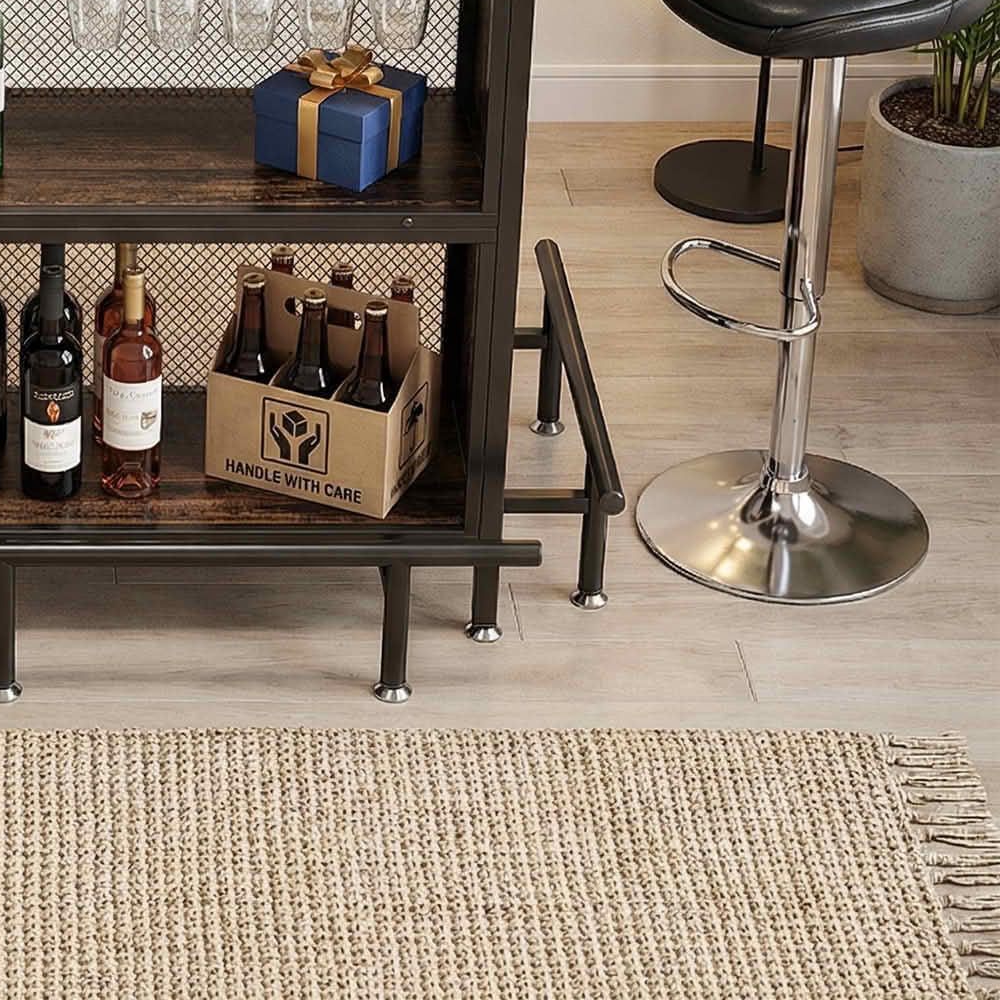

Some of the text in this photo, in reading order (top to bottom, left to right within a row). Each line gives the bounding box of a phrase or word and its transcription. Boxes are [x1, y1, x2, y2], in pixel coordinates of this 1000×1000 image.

[225, 458, 363, 504] HANDLE WITH CARE
